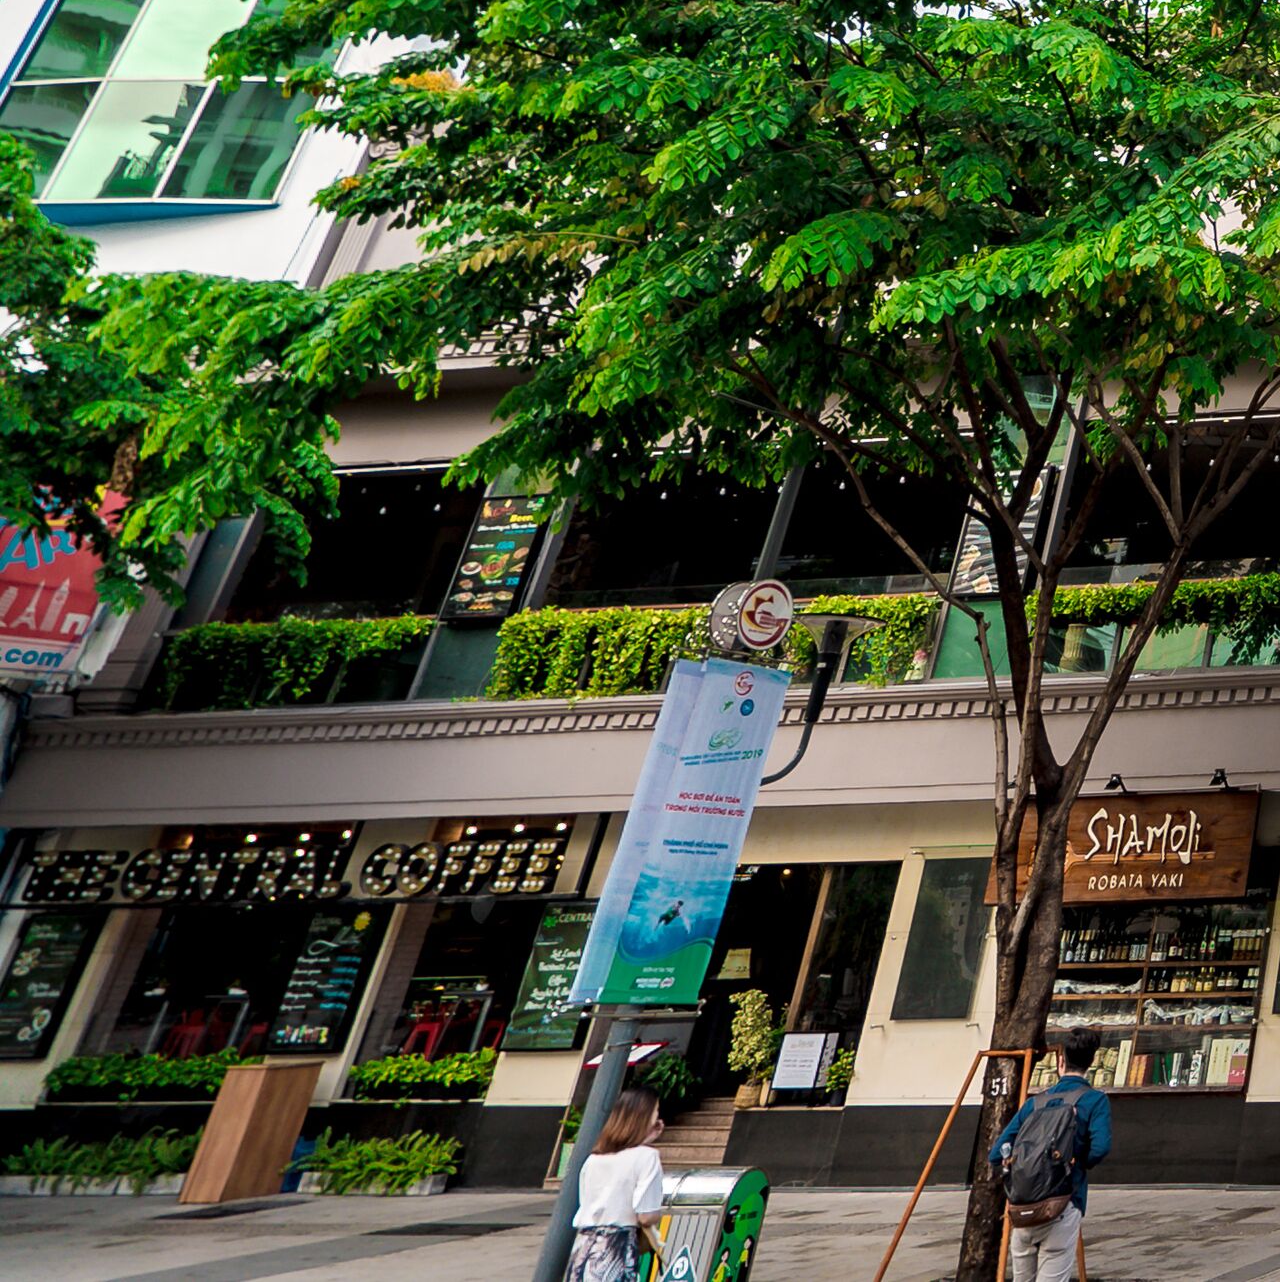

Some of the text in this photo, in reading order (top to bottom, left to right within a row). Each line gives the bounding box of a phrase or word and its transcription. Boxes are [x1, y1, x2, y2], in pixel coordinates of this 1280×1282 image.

[741, 748, 763, 760] 2019
[22, 838, 565, 903] THE CENTRAL COFFEE
[1088, 872, 1183, 891] ROBATA YAKI
[557, 912, 594, 924] CENTRA
[990, 1076, 1009, 1097] 51
